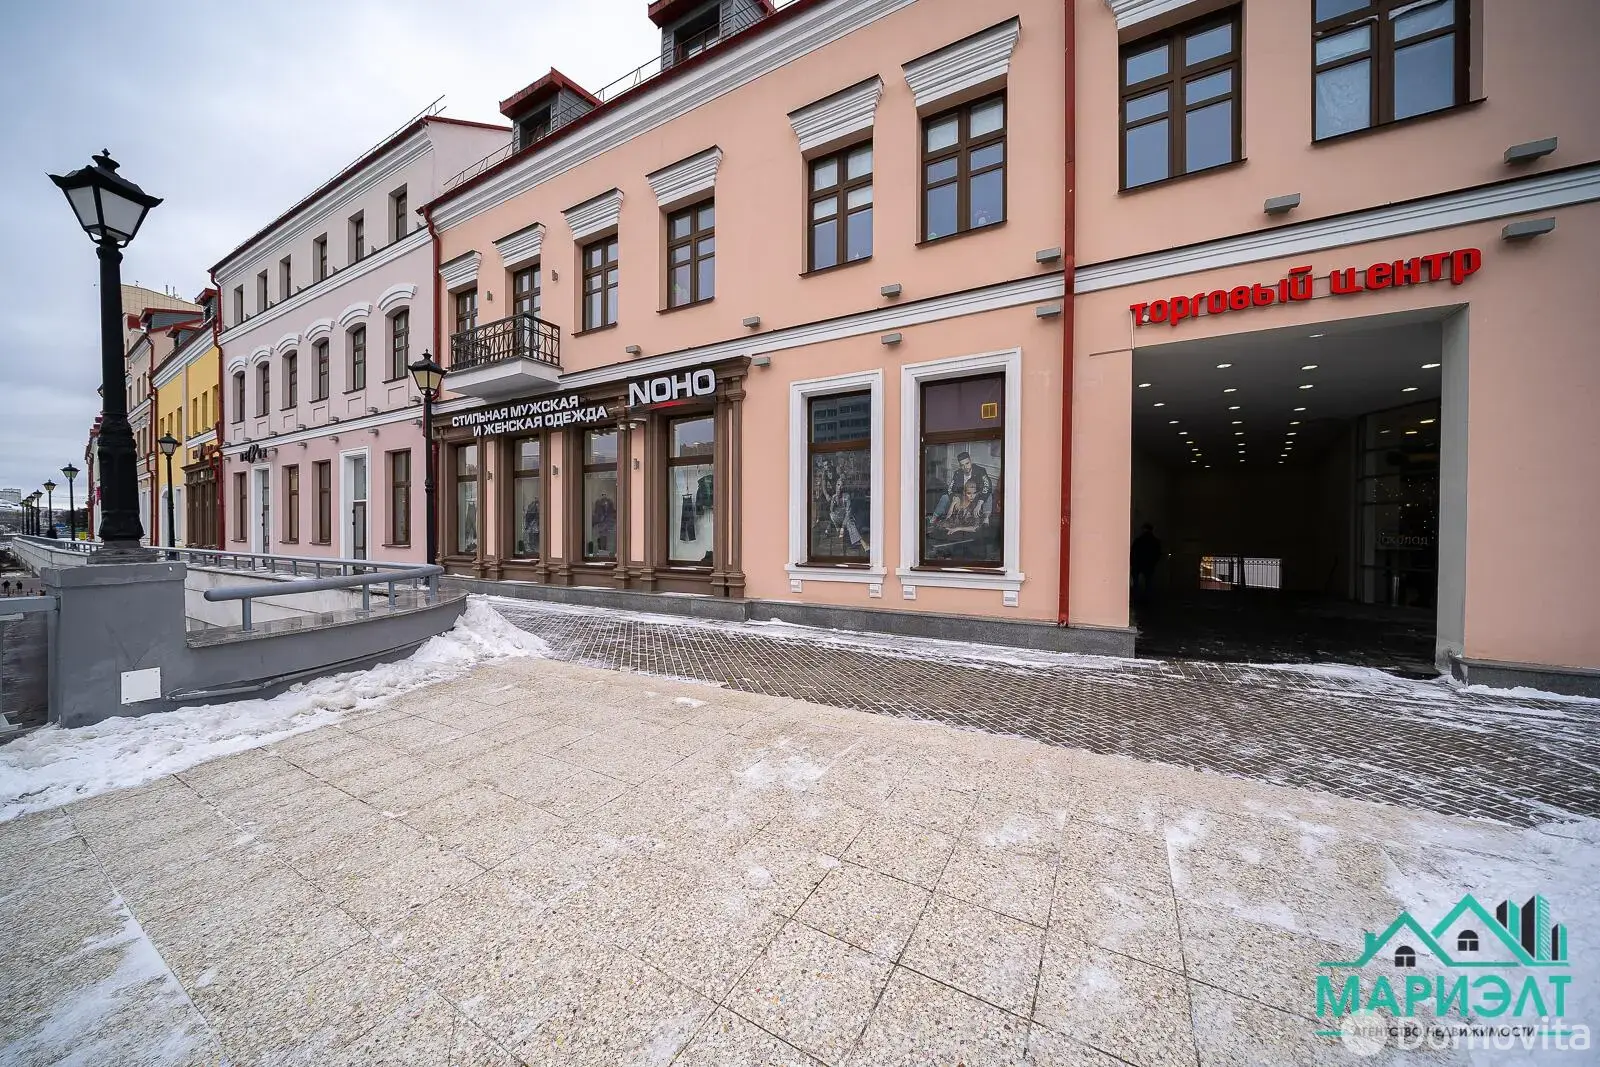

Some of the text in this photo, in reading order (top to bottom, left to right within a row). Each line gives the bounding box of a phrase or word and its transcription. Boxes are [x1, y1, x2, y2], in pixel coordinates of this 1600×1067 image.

[1130, 247, 1482, 327] торговый центр
[628, 368, 716, 408] NOHO
[451, 395, 579, 428] СТИЛЬНАЯ МУЖСКАЯ
[472, 405, 608, 437] И ЖЕНСКАЯ ОДЕЖДА
